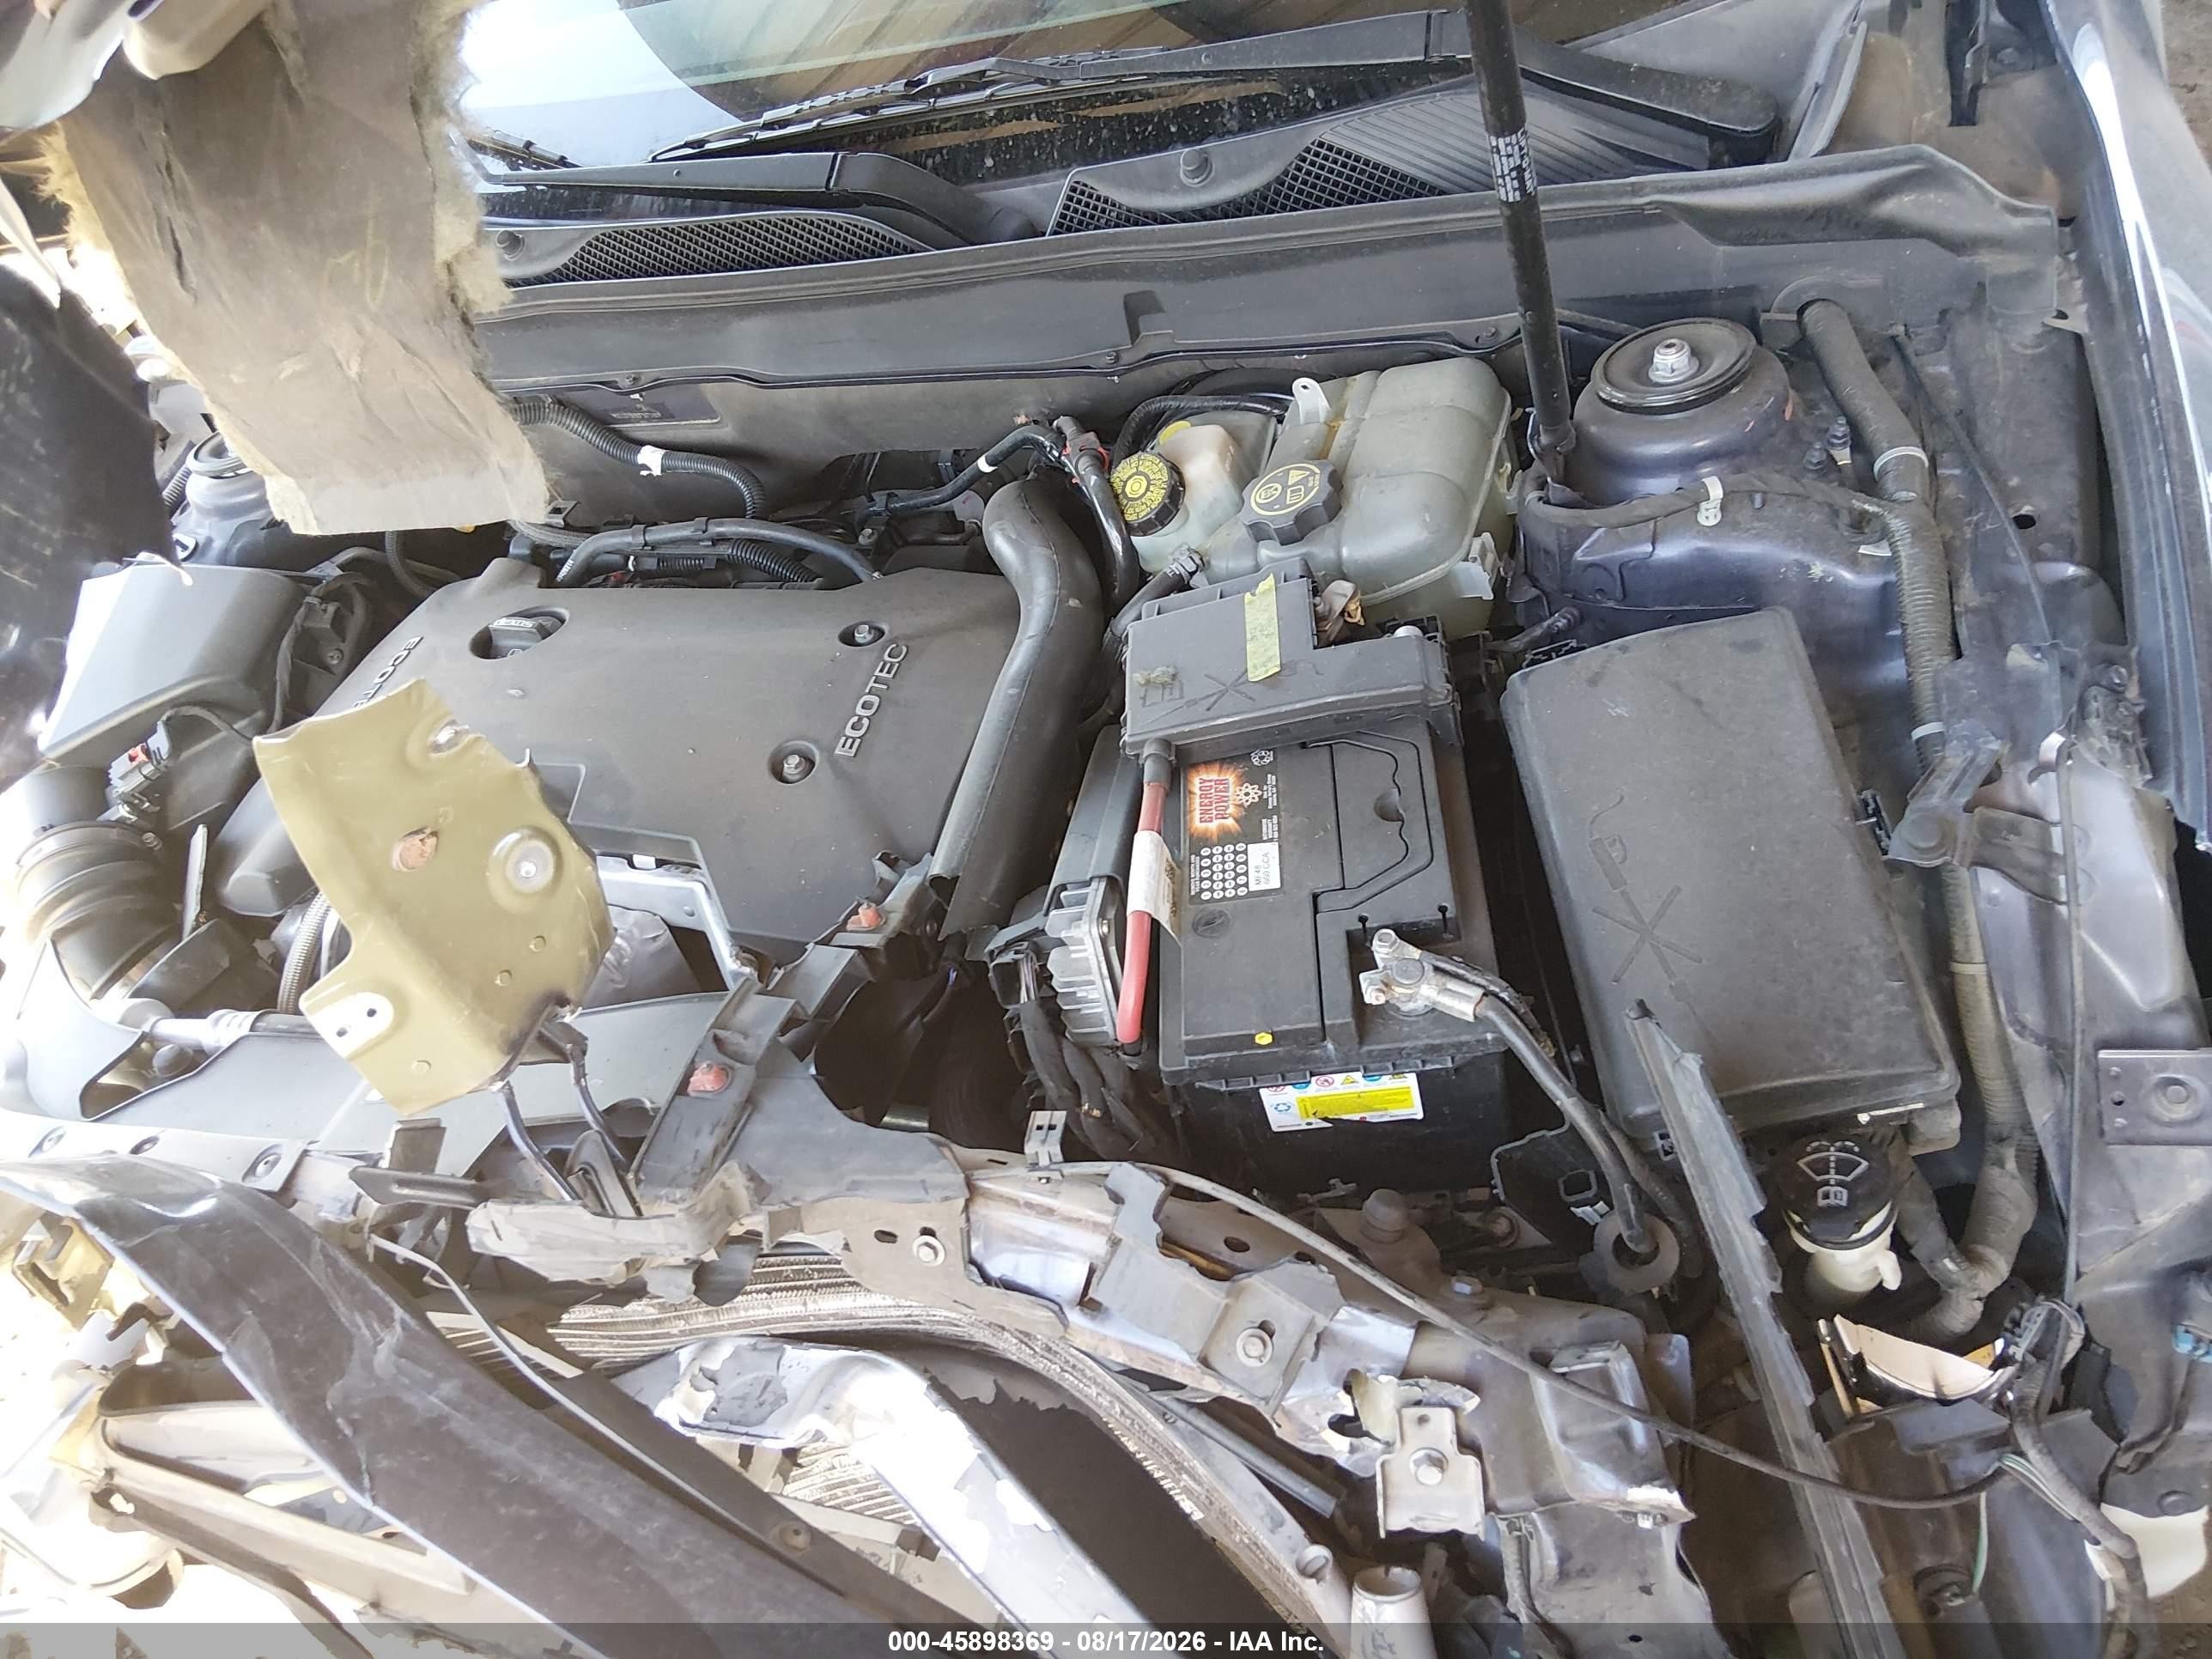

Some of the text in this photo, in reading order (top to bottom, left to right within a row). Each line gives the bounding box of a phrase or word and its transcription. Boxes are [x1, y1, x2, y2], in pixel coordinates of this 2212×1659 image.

[834, 642, 908, 758] ECOTEC
[1198, 777, 1214, 824] ENERGY
[1213, 778, 1230, 821] POWER
[1261, 852, 1270, 869] CCA
